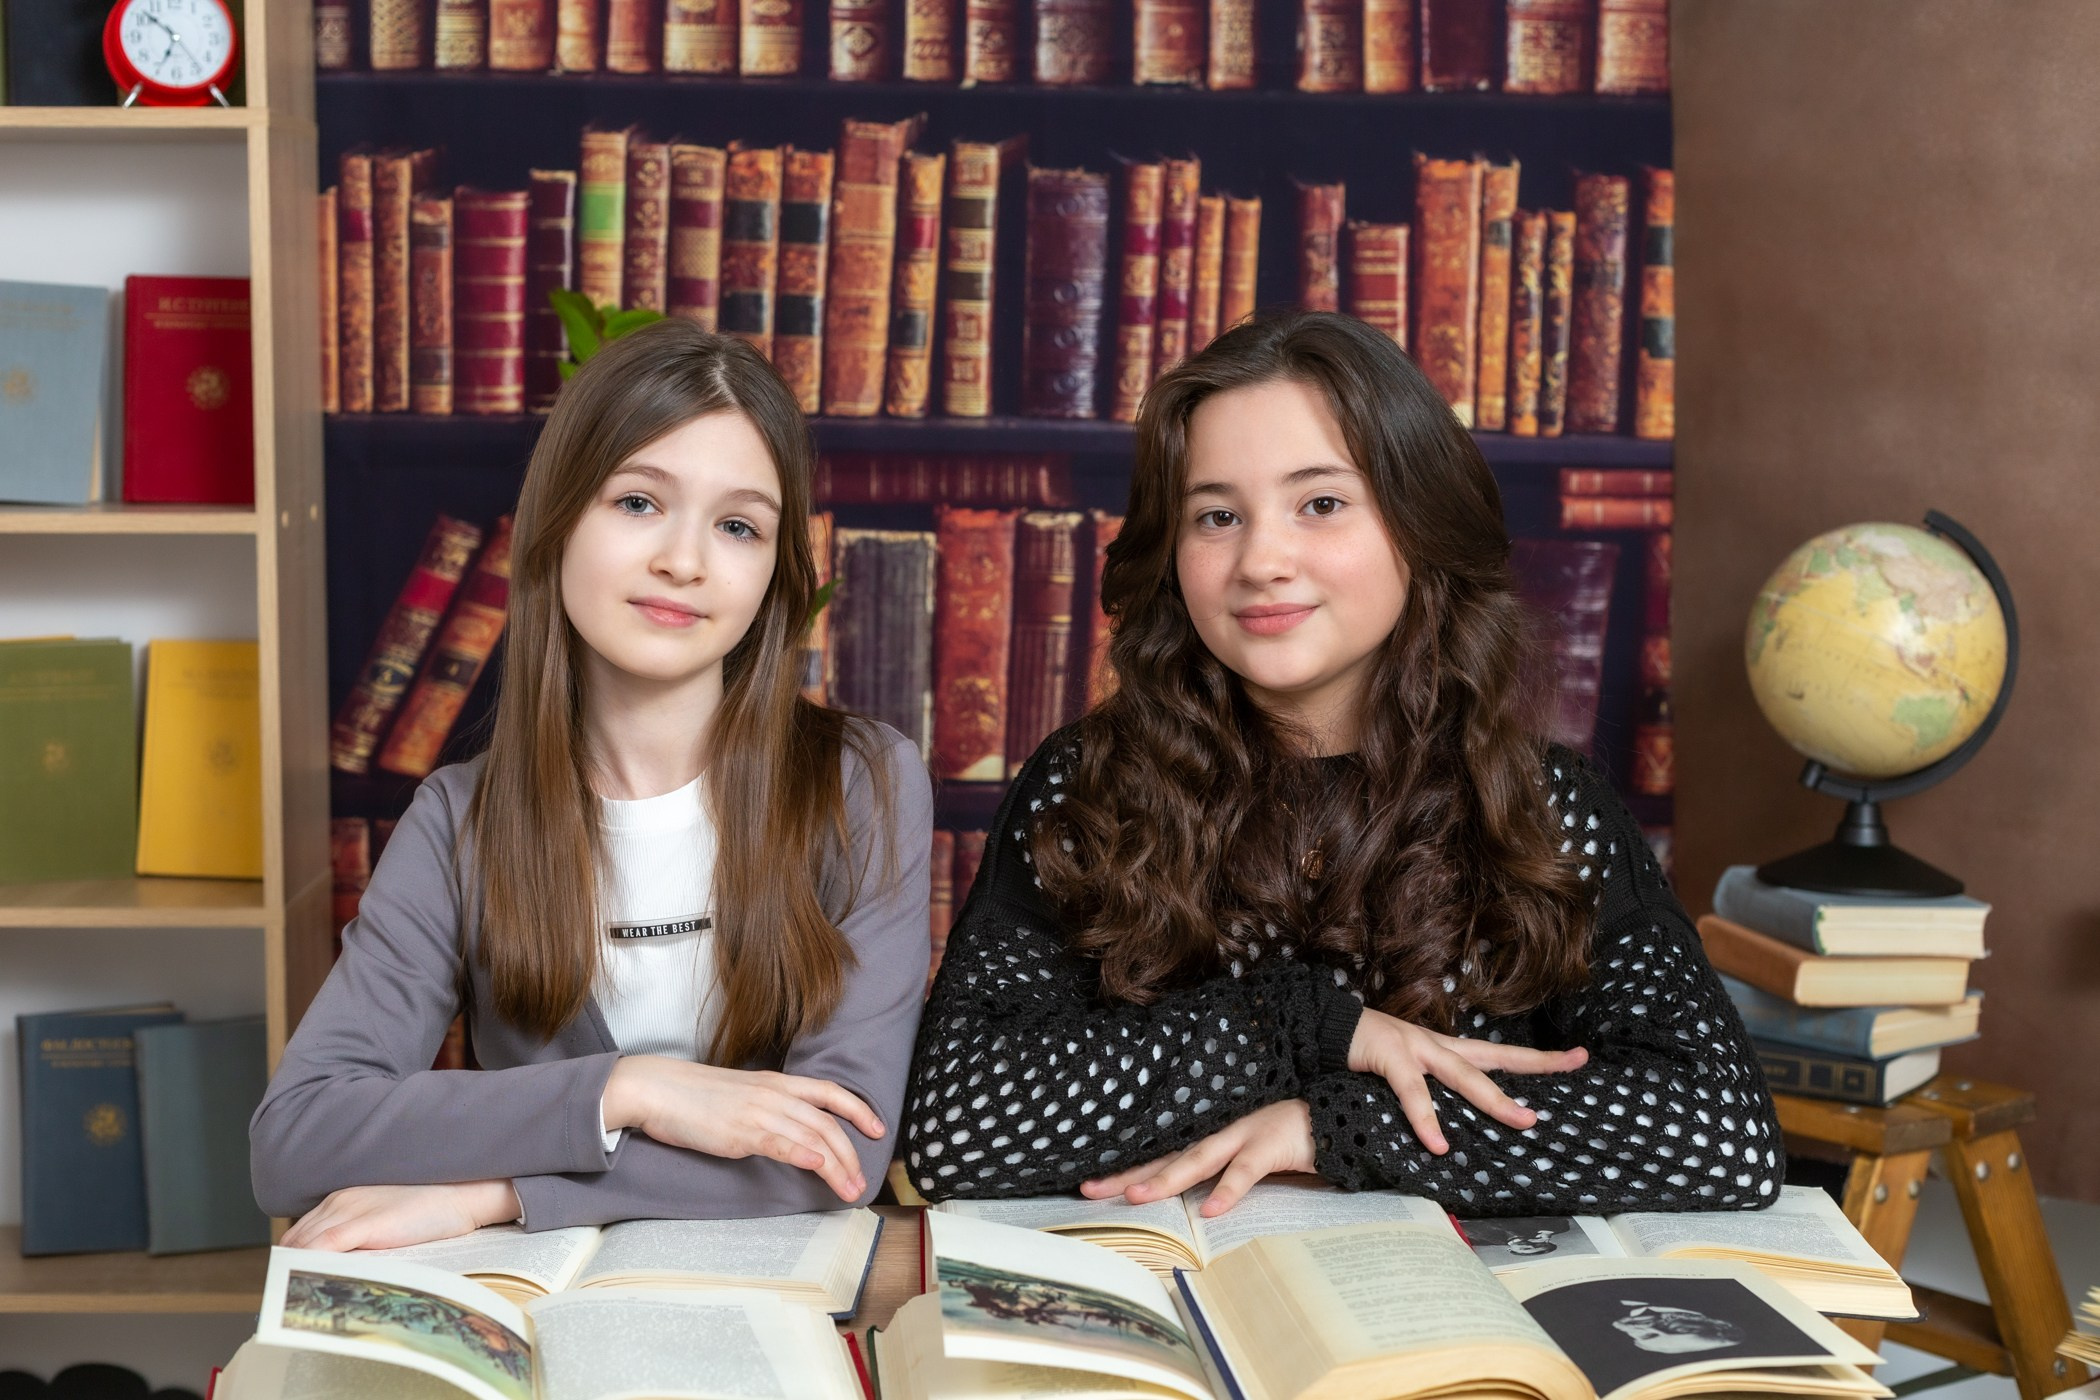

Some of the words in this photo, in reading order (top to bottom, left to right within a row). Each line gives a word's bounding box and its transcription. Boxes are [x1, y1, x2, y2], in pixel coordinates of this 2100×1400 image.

[150, 0, 161, 12] 11
[191, 1, 197, 14] 1
[130, 30, 142, 43] 9
[204, 50, 212, 62] 4
[171, 66, 182, 79] 6
[622, 927, 648, 938] WEAR
[651, 924, 668, 936] THE
[672, 921, 696, 933] BEST
